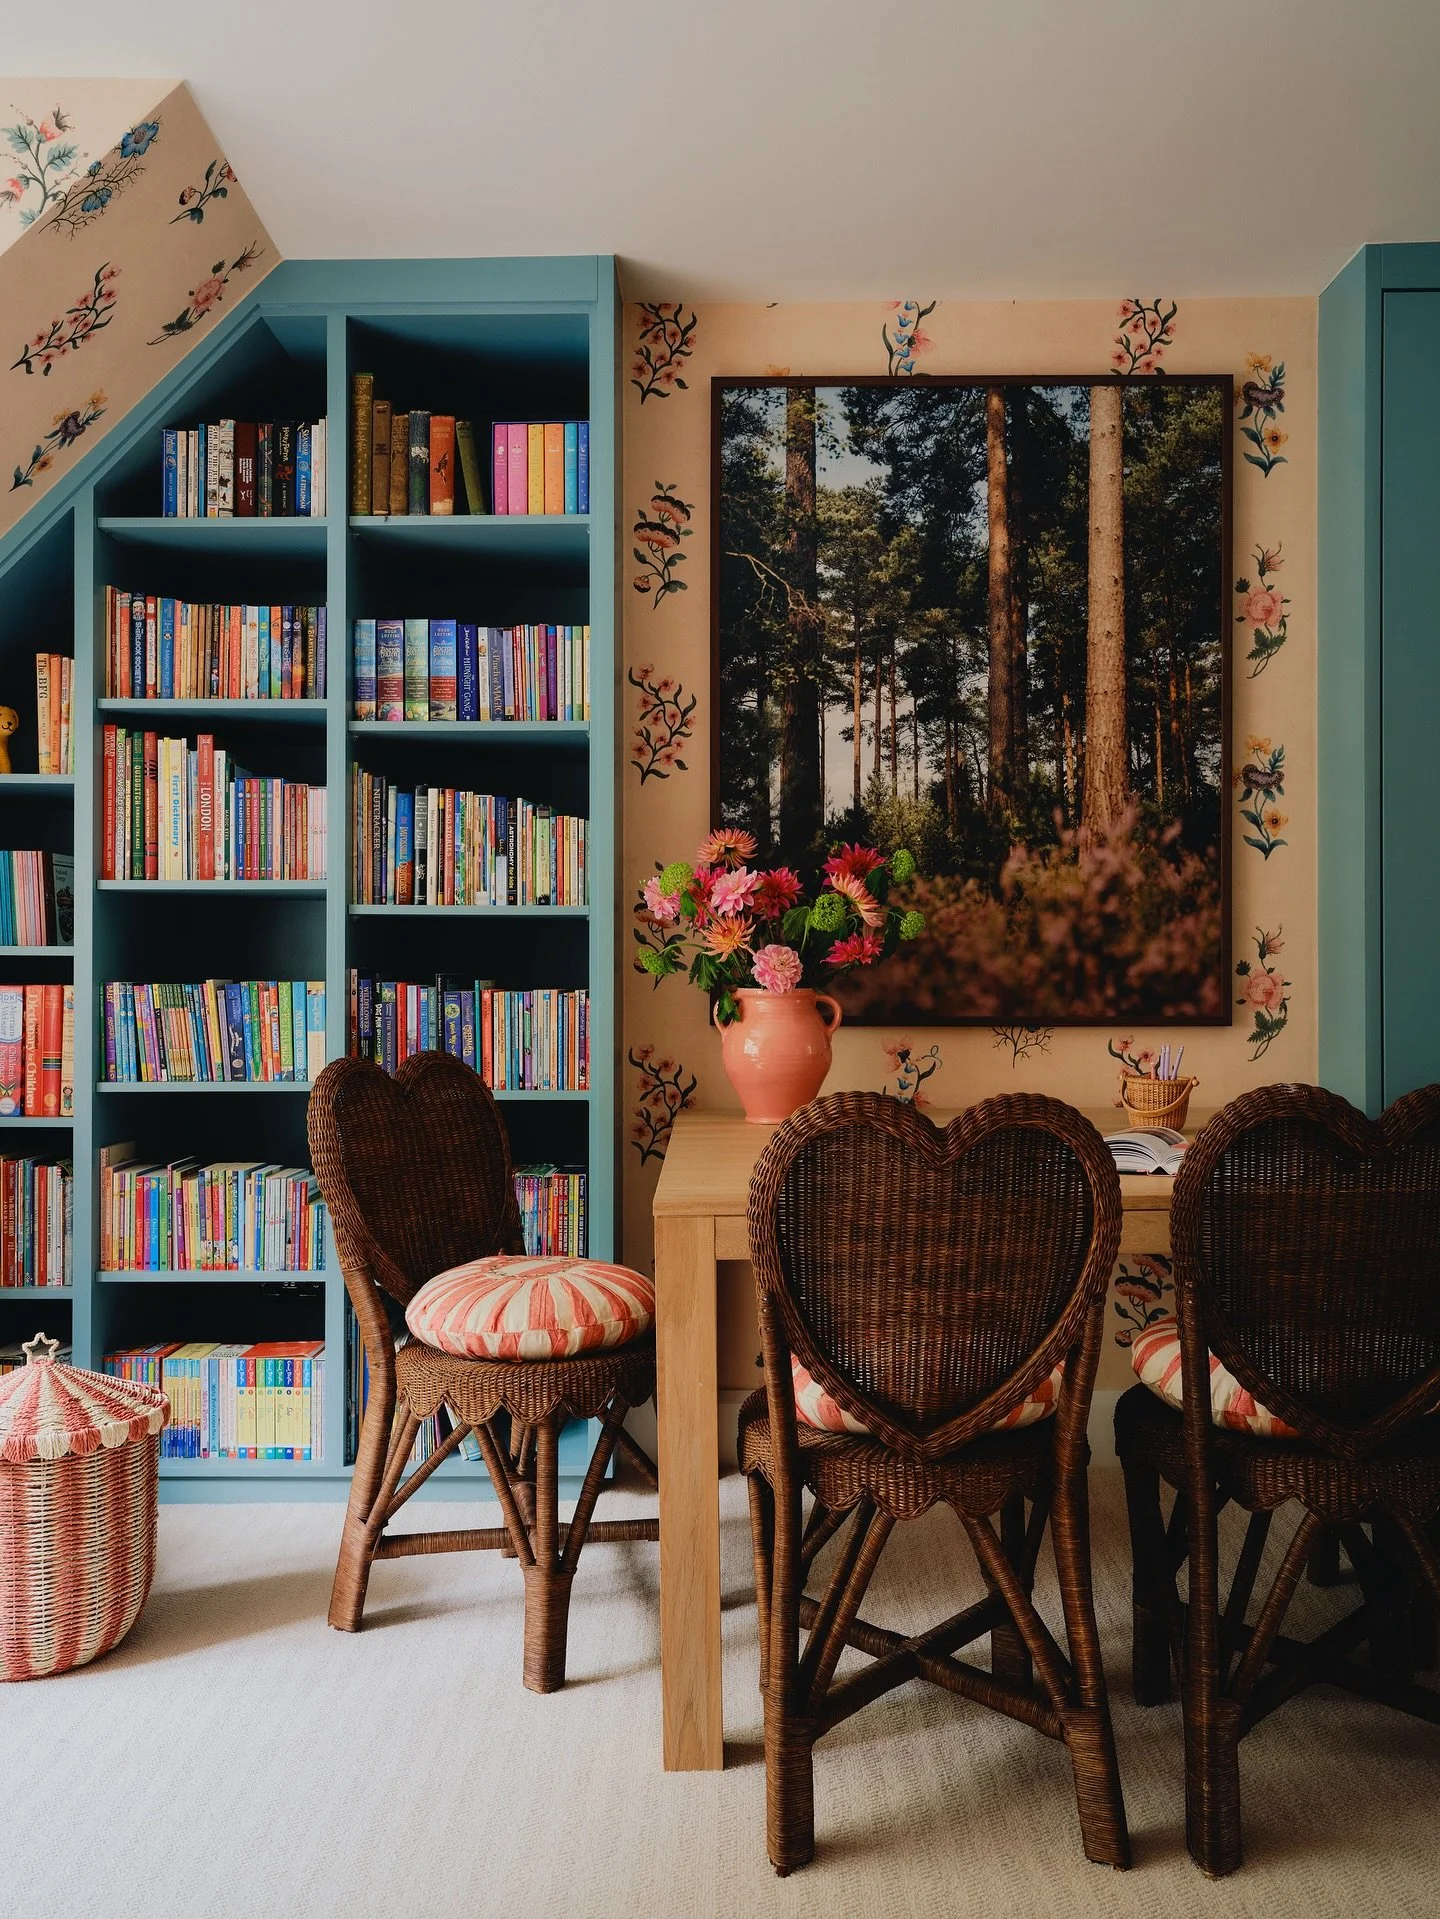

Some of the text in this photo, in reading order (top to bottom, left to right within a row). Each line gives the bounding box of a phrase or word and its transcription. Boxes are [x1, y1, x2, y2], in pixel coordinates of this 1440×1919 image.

[301, 429, 310, 456] SKANDAR
[307, 629, 315, 662] BEANSTALK
[38, 658, 48, 699] The BFG
[463, 657, 472, 712] MIDNIGHT GANG
[492, 655, 500, 677] Pinch
[494, 685, 502, 714] MAGIC
[172, 775, 180, 846] First Dictionary
[201, 788, 212, 831] LONDON
[373, 788, 381, 850] NUTCRACKER
[447, 814, 452, 823] SO
[399, 826, 409, 894] IMPOSSIBLE CREATURES
[3, 994, 16, 1002] DK
[106, 985, 114, 1003] DAISY
[26, 994, 38, 1051] Dictionary
[296, 1010, 304, 1069] NATURE STORIES
[8, 1045, 17, 1082] Children's
[282, 1029, 290, 1065] STORIES
[26, 1062, 37, 1108] Children
